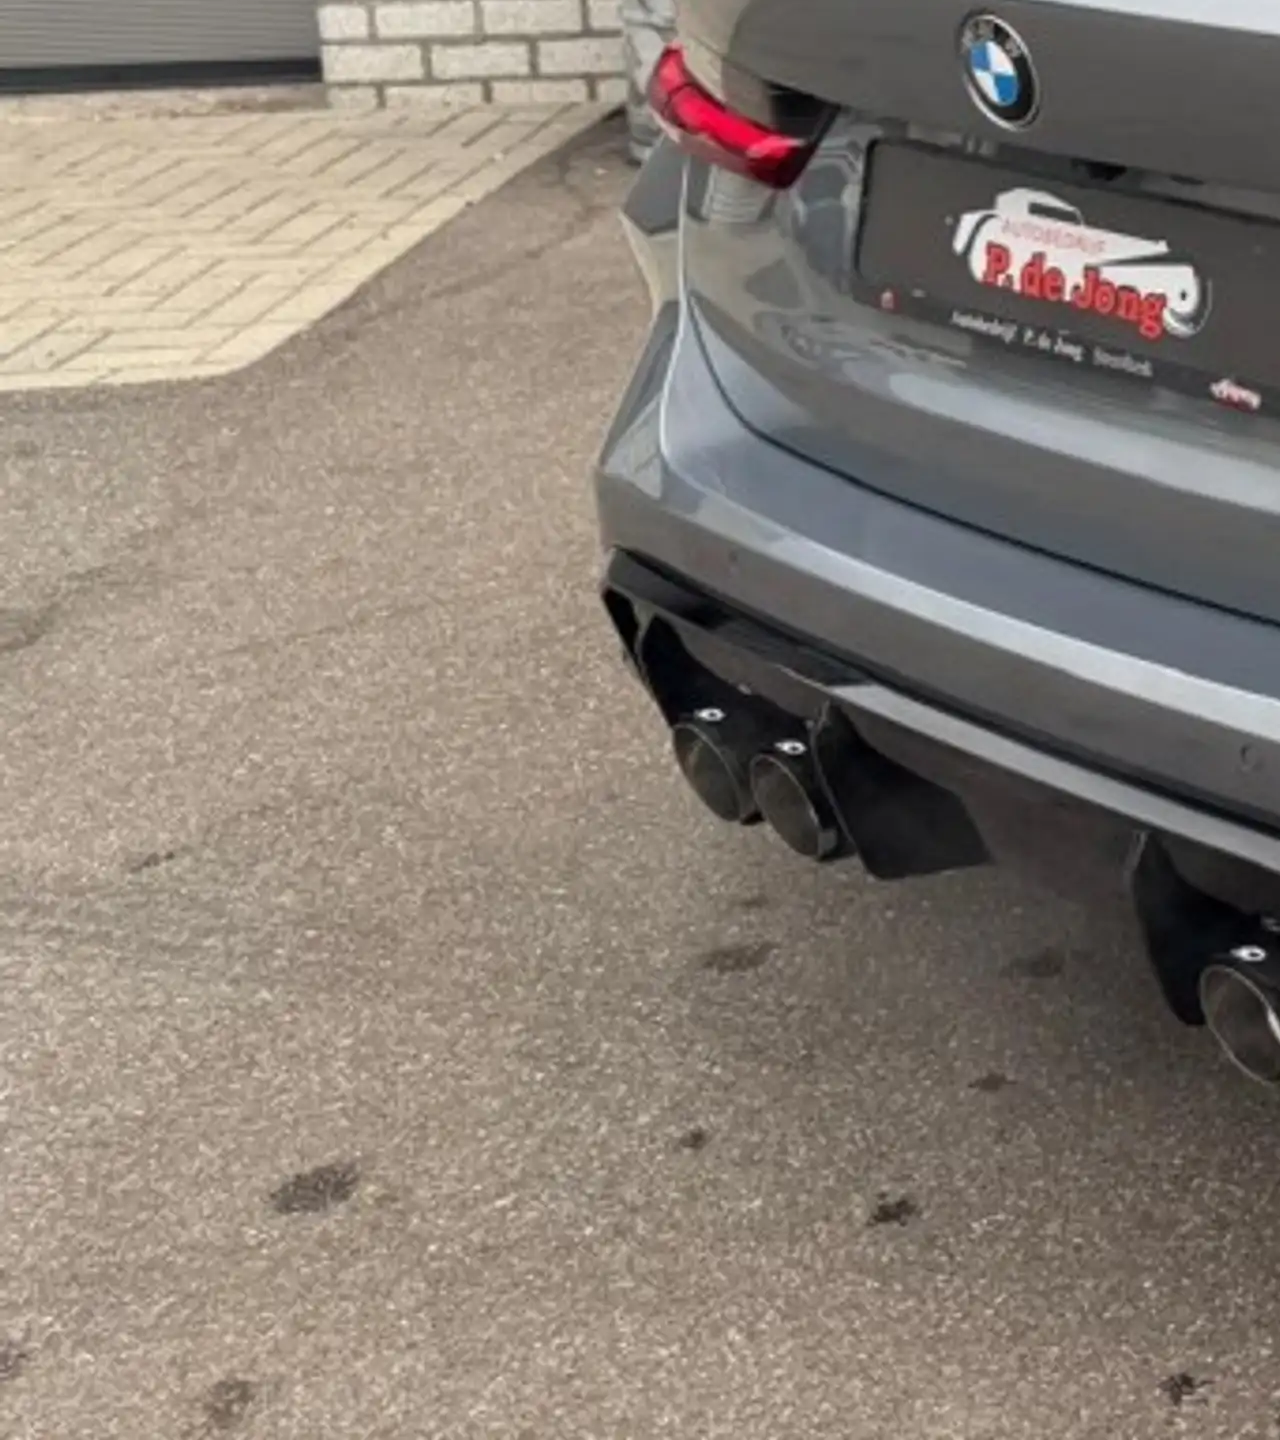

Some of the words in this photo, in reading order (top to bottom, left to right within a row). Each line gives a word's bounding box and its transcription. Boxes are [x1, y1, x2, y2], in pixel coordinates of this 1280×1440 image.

[984, 240, 1014, 287] P.
[1021, 251, 1066, 301] de
[1071, 262, 1168, 341] Jong
